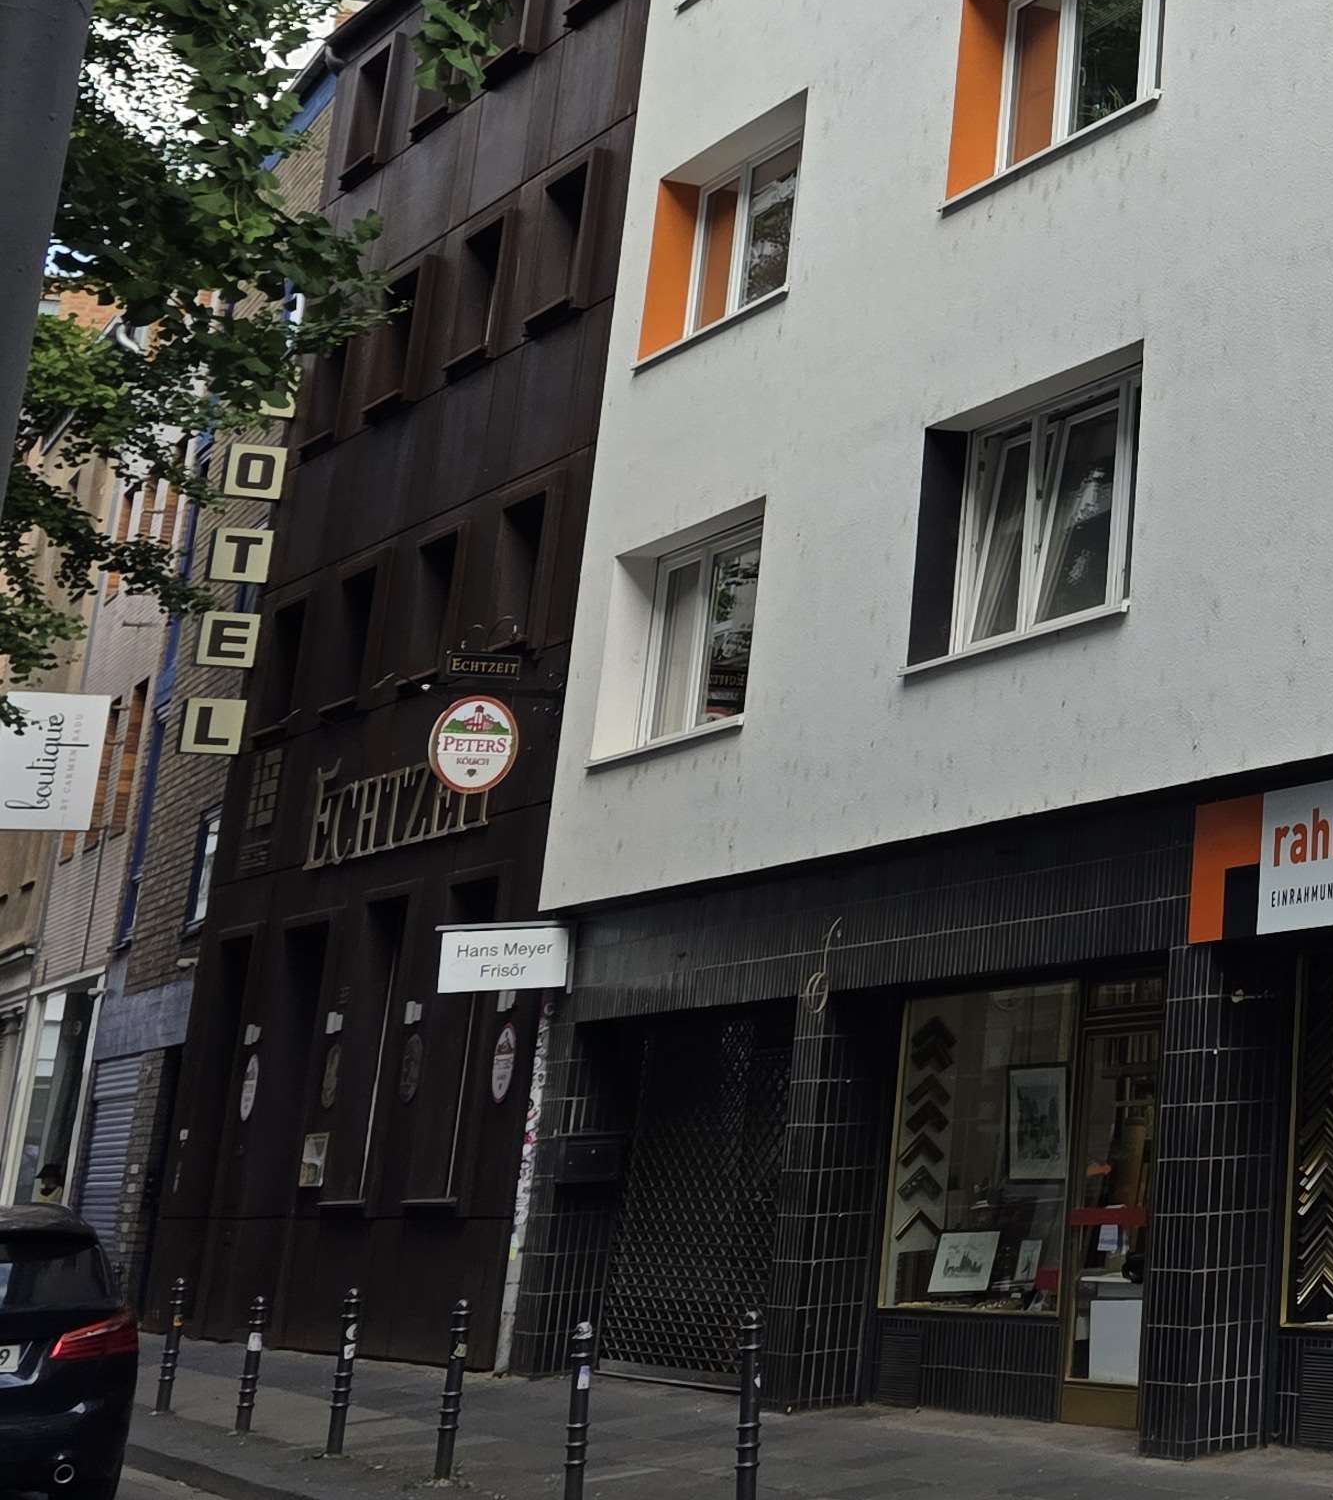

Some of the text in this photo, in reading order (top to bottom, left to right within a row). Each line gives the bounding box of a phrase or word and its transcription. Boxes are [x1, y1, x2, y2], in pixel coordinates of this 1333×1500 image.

[191, 451, 278, 747] OTEL
[451, 657, 518, 675] ECHTZEIT
[443, 735, 507, 754] PETERS
[5, 712, 90, 810] boutique
[457, 941, 553, 959] Hans Meyer
[480, 963, 527, 979] Frisör
